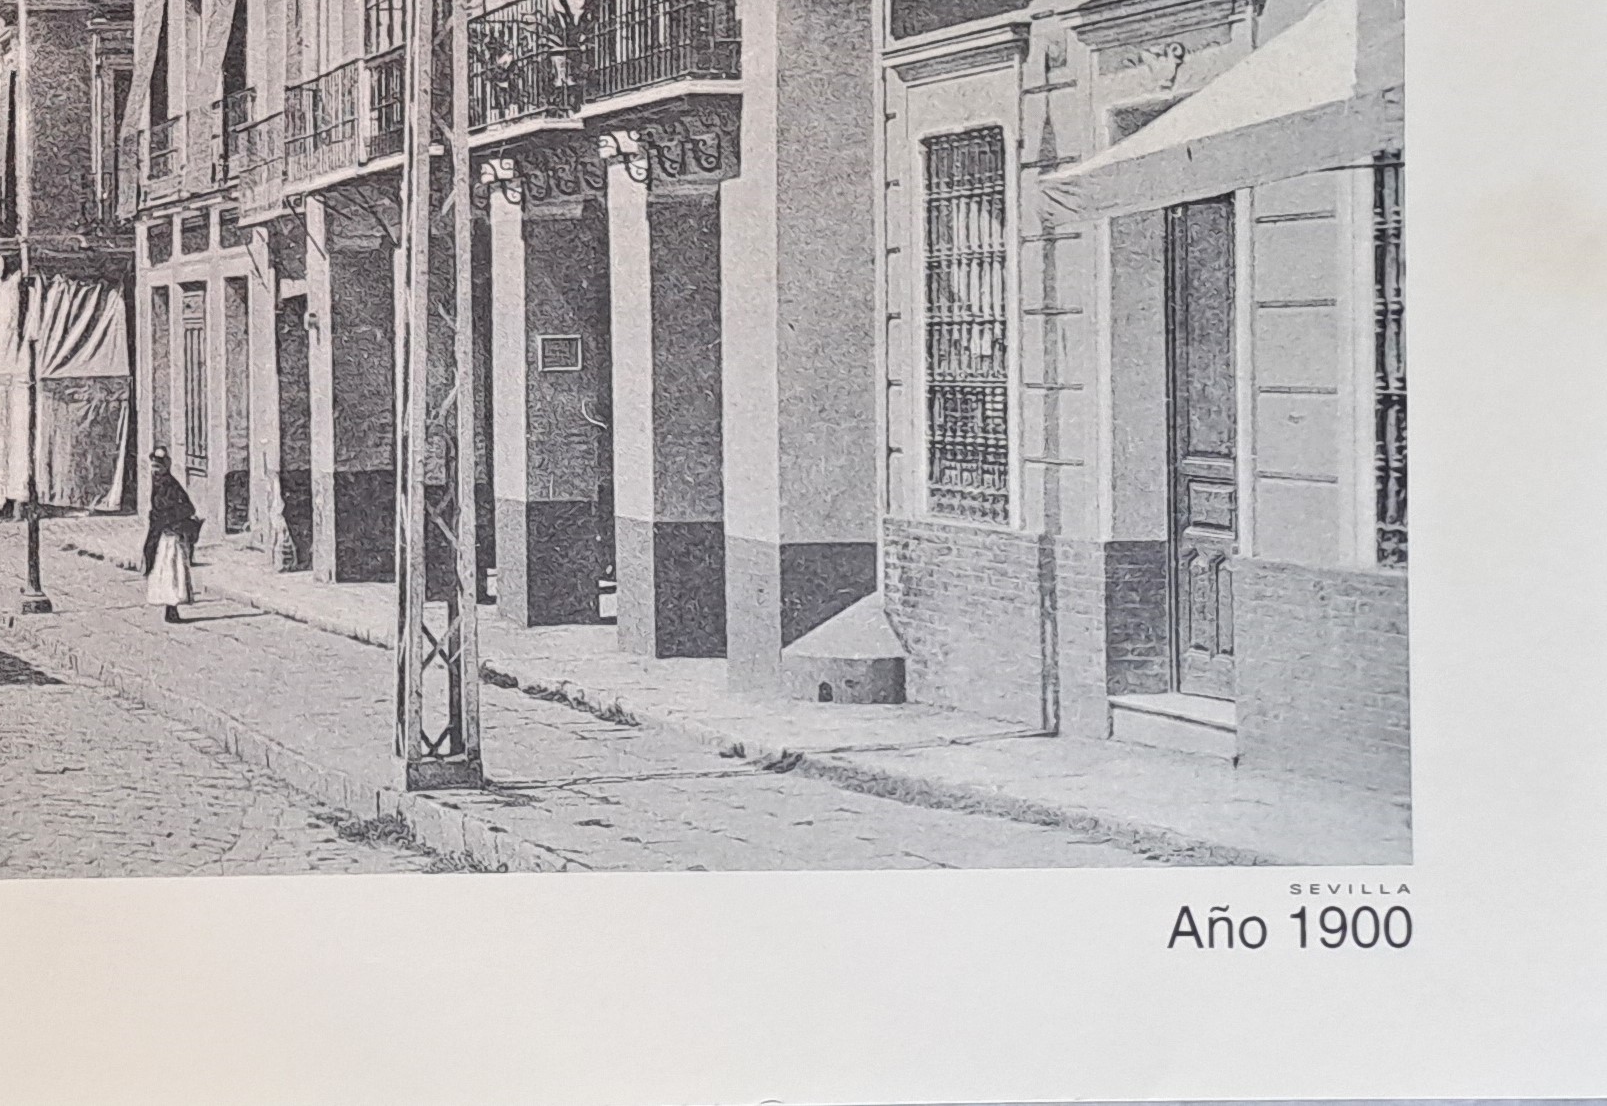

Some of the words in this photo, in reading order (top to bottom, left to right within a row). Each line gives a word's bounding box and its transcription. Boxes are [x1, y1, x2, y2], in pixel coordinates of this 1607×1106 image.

[1289, 883, 1411, 895] SEVILLA
[1166, 904, 1268, 950] Año
[1289, 905, 1414, 950] 1900
